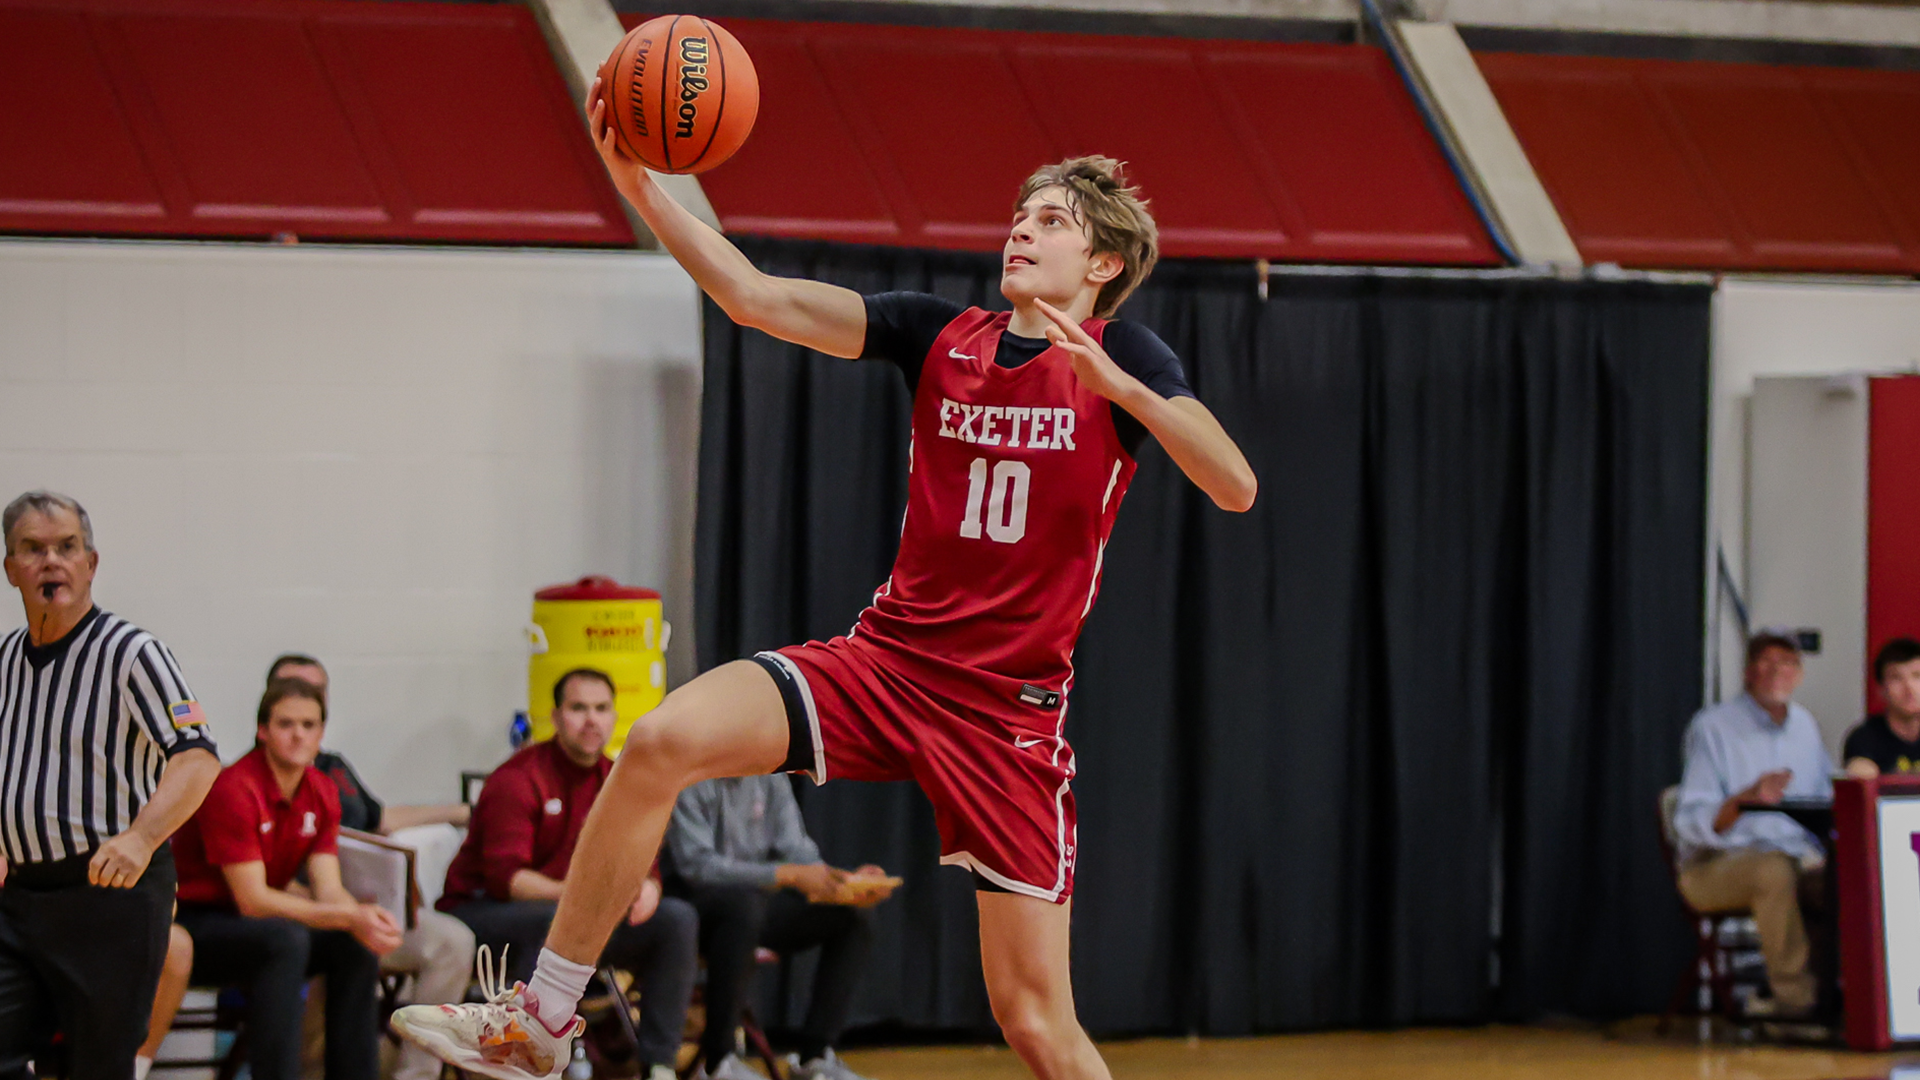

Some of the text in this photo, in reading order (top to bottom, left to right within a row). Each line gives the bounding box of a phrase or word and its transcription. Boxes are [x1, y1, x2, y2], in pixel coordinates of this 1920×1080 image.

[631, 38, 653, 137] EVOLUTION
[674, 36, 710, 139] Wilson
[938, 397, 1077, 451] EXETER
[959, 457, 1031, 544] 10
